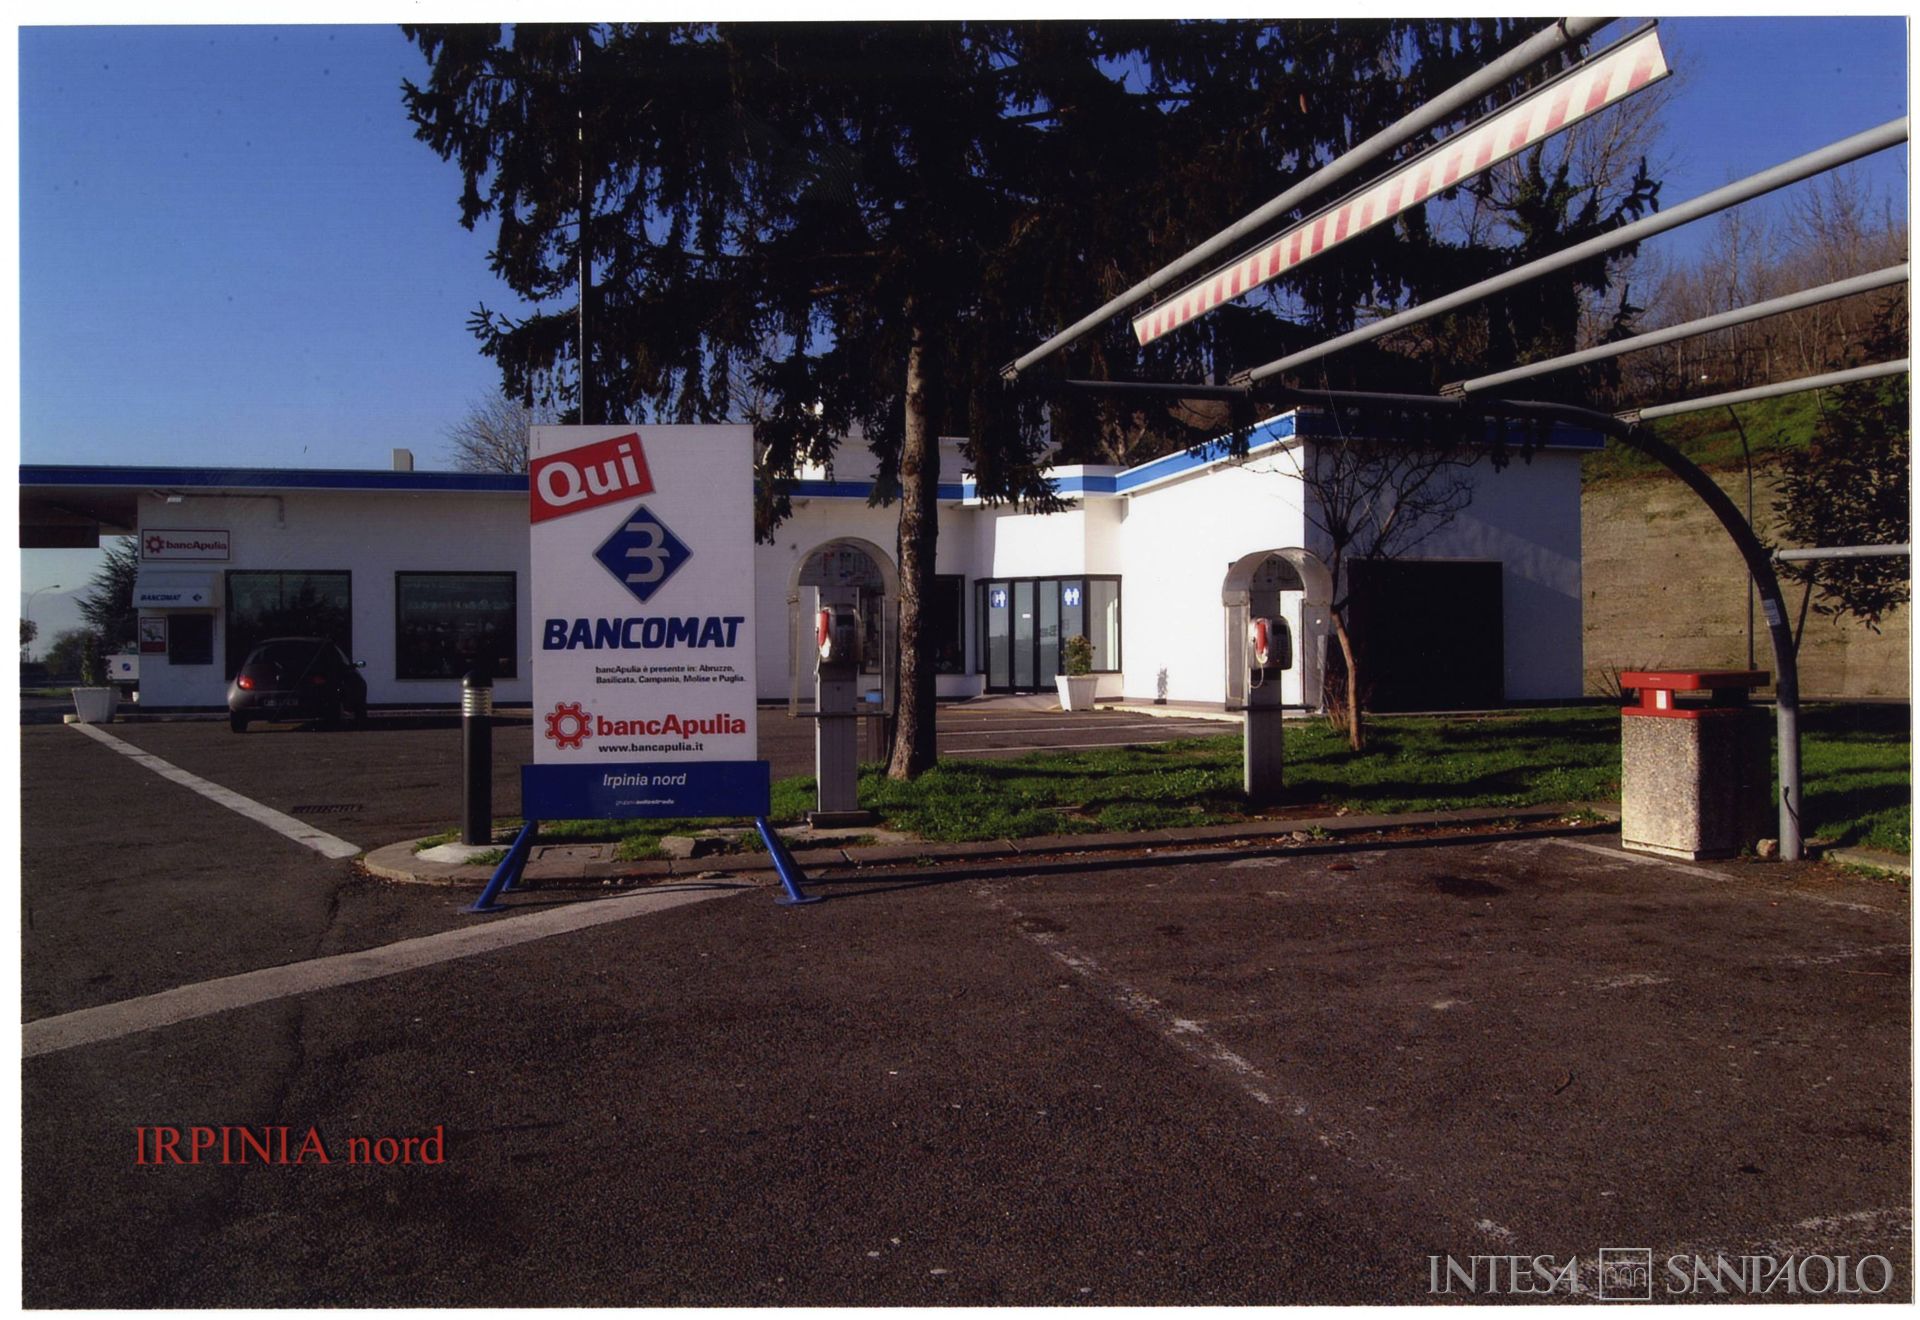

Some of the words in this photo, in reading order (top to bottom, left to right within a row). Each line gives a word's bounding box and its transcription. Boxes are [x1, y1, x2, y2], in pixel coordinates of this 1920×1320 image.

[537, 443, 640, 506] Qui
[166, 540, 227, 551] bancApulia
[543, 616, 744, 650] BANCOMAT
[595, 666, 641, 675] bancApulia
[650, 666, 686, 674] presente
[596, 676, 637, 684] Basilicata,
[597, 713, 746, 739] bancApulia
[598, 741, 704, 753] www.bancapulia.it
[603, 773, 648, 789] Irpinia
[652, 773, 687, 786] nord
